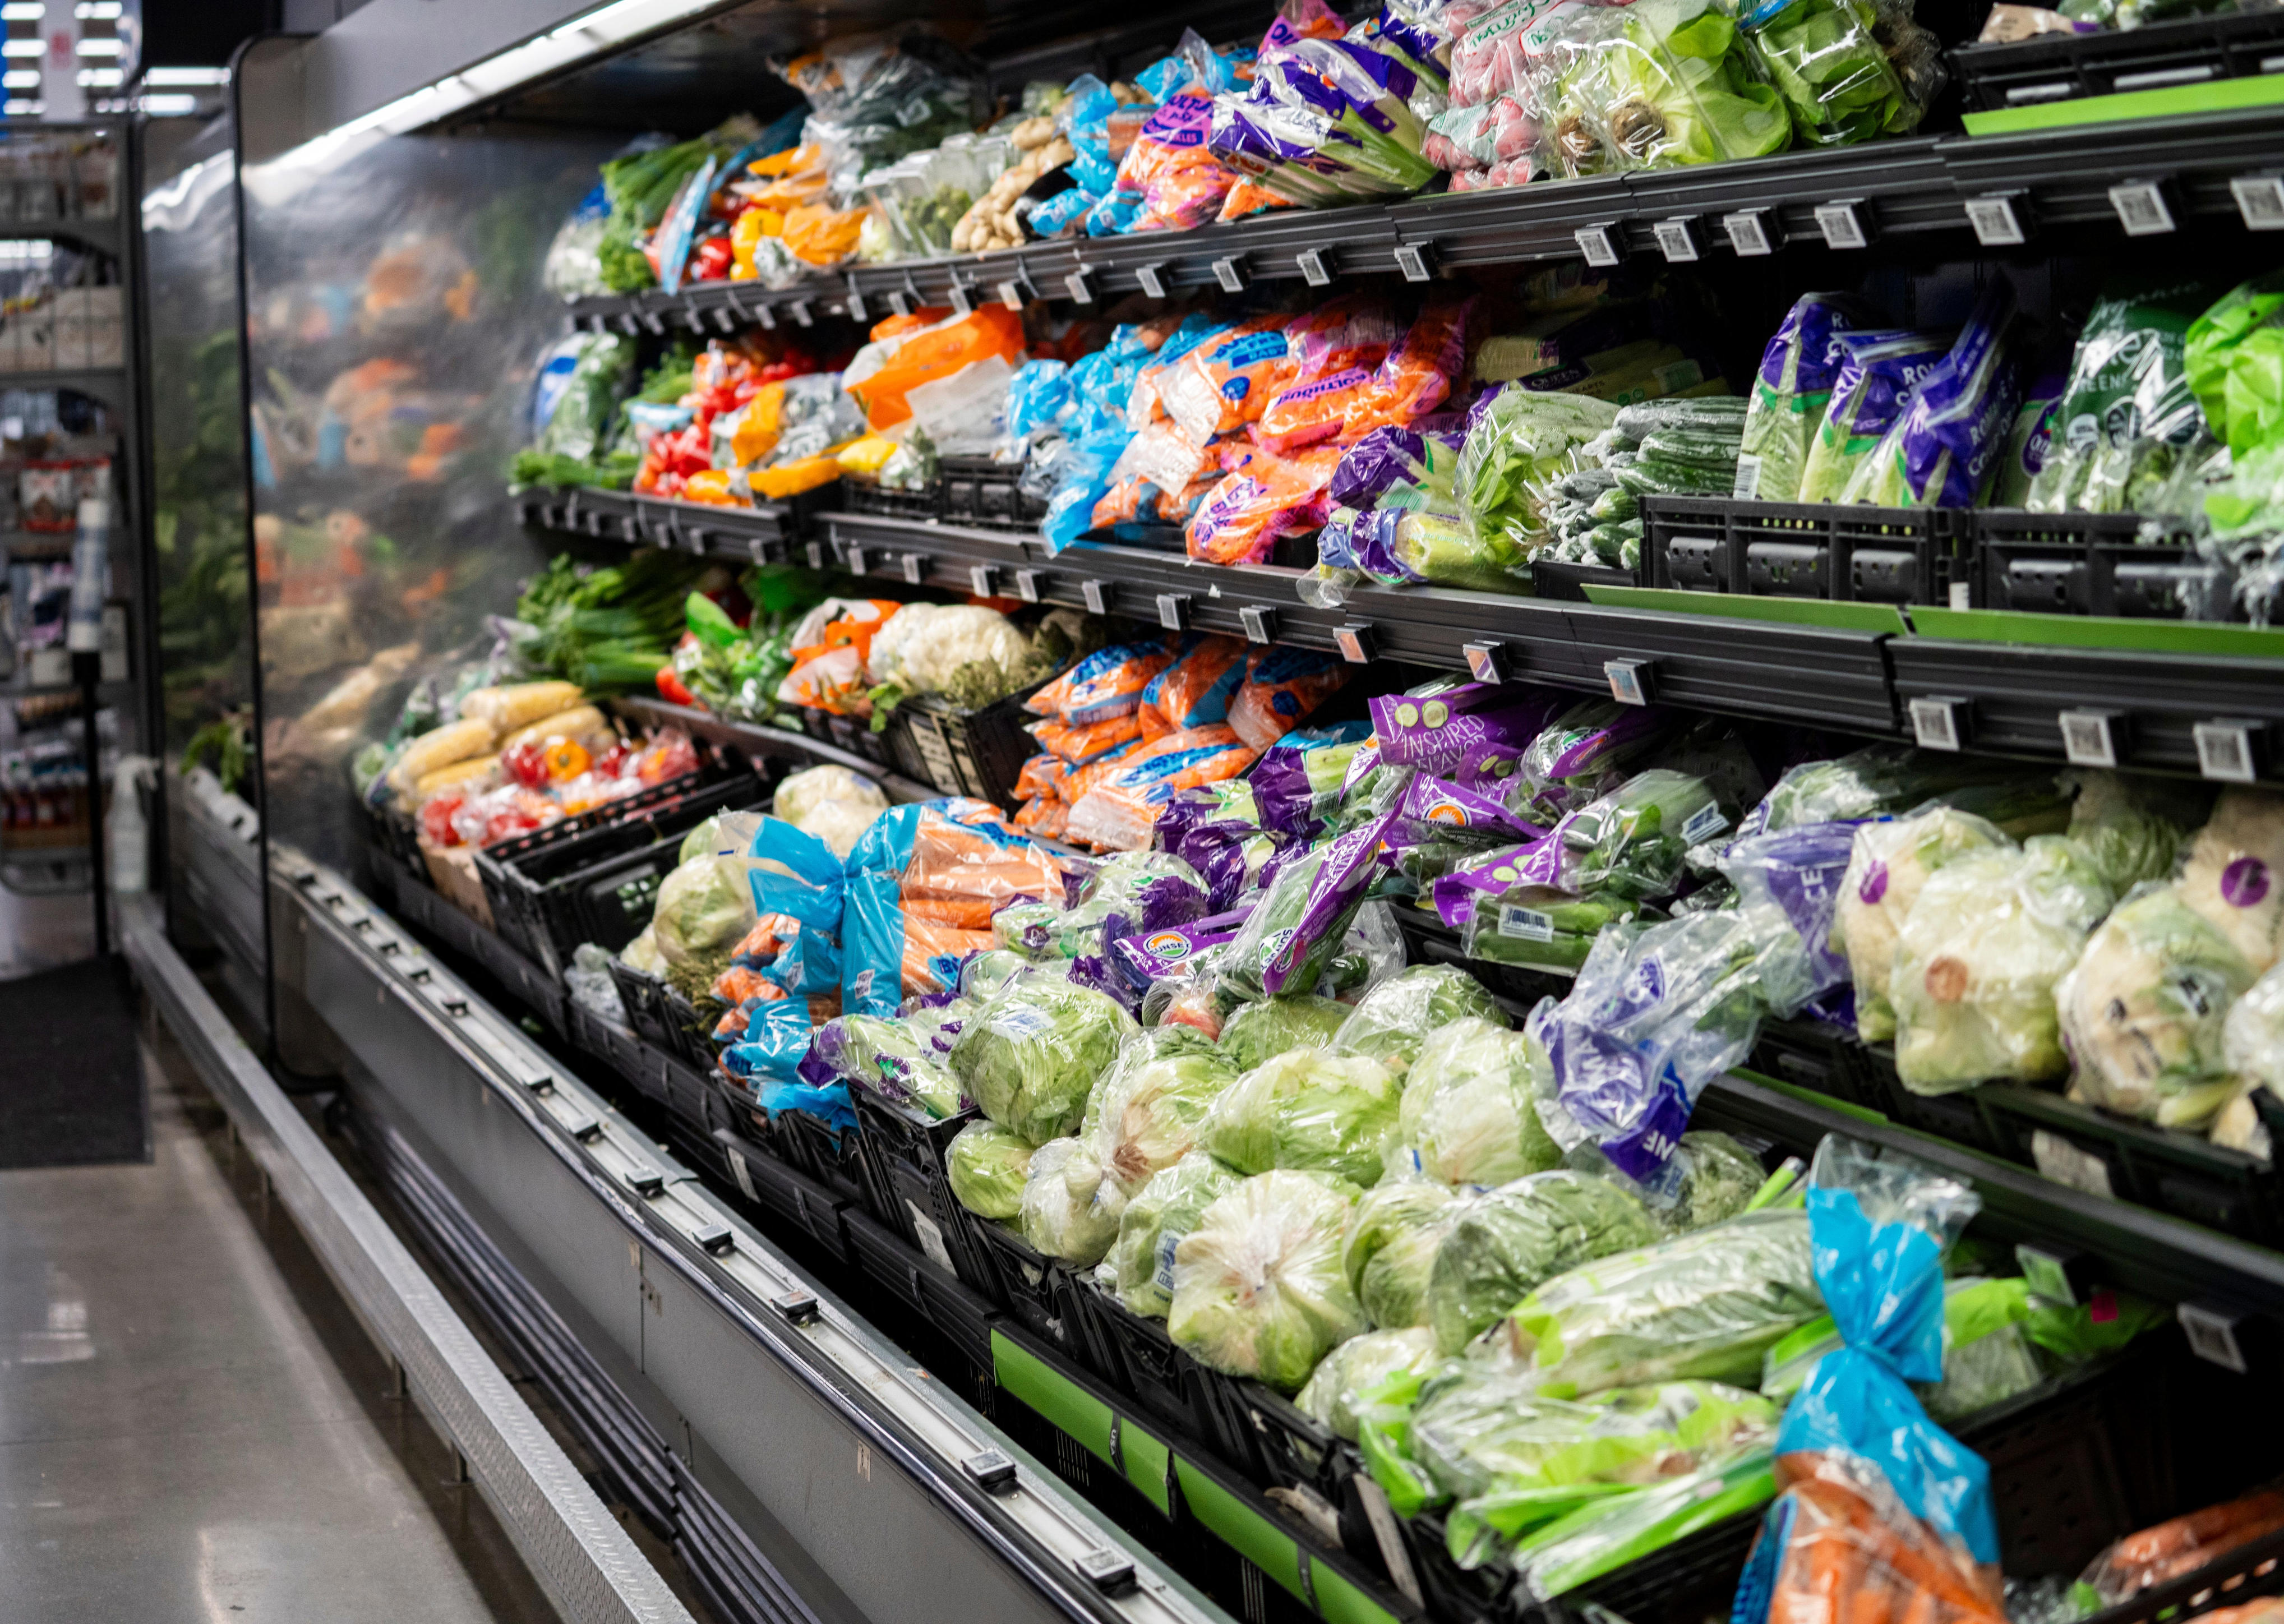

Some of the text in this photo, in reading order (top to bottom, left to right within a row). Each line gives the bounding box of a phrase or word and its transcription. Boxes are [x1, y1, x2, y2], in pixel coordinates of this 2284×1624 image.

[1401, 714, 1485, 759] INSPIRED
[1416, 733, 1487, 772] FLAVO
[1149, 942, 1189, 954] SUNSET
